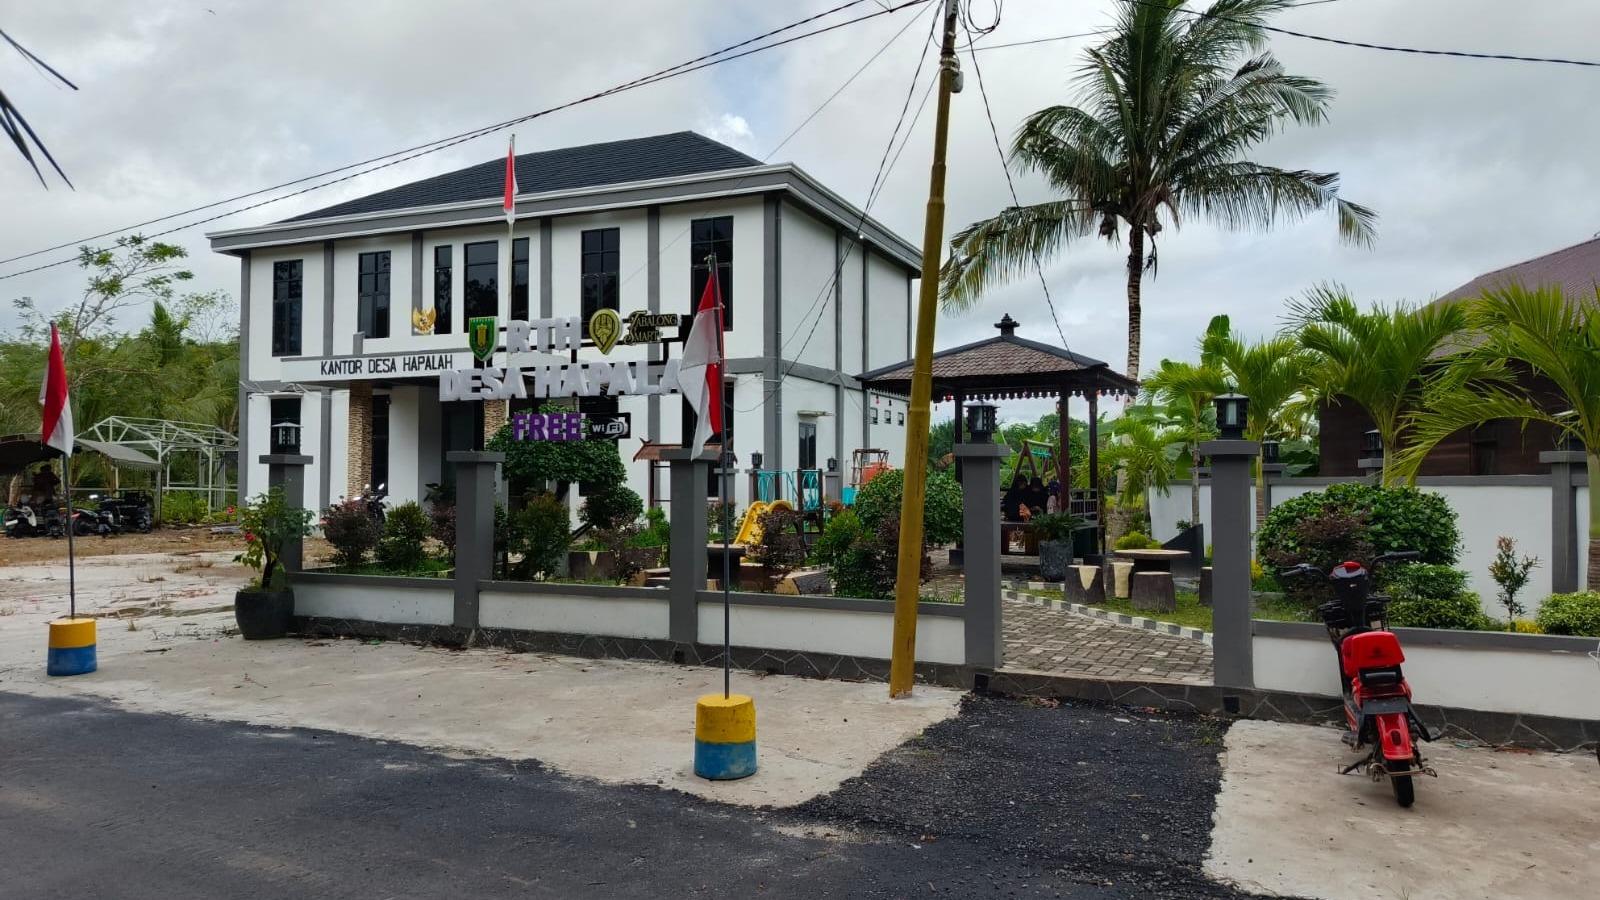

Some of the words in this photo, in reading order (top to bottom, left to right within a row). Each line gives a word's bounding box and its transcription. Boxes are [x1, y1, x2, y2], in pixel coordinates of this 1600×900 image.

[628, 310, 678, 327] TABALONG
[507, 316, 582, 354] RTH
[624, 327, 660, 343] SMART
[320, 359, 363, 376] KANTOR
[368, 357, 397, 374] DESA
[403, 354, 453, 372] HAPALAH
[439, 367, 528, 402] DESA
[534, 358, 684, 399] HAPALA
[513, 413, 585, 441] FREE
